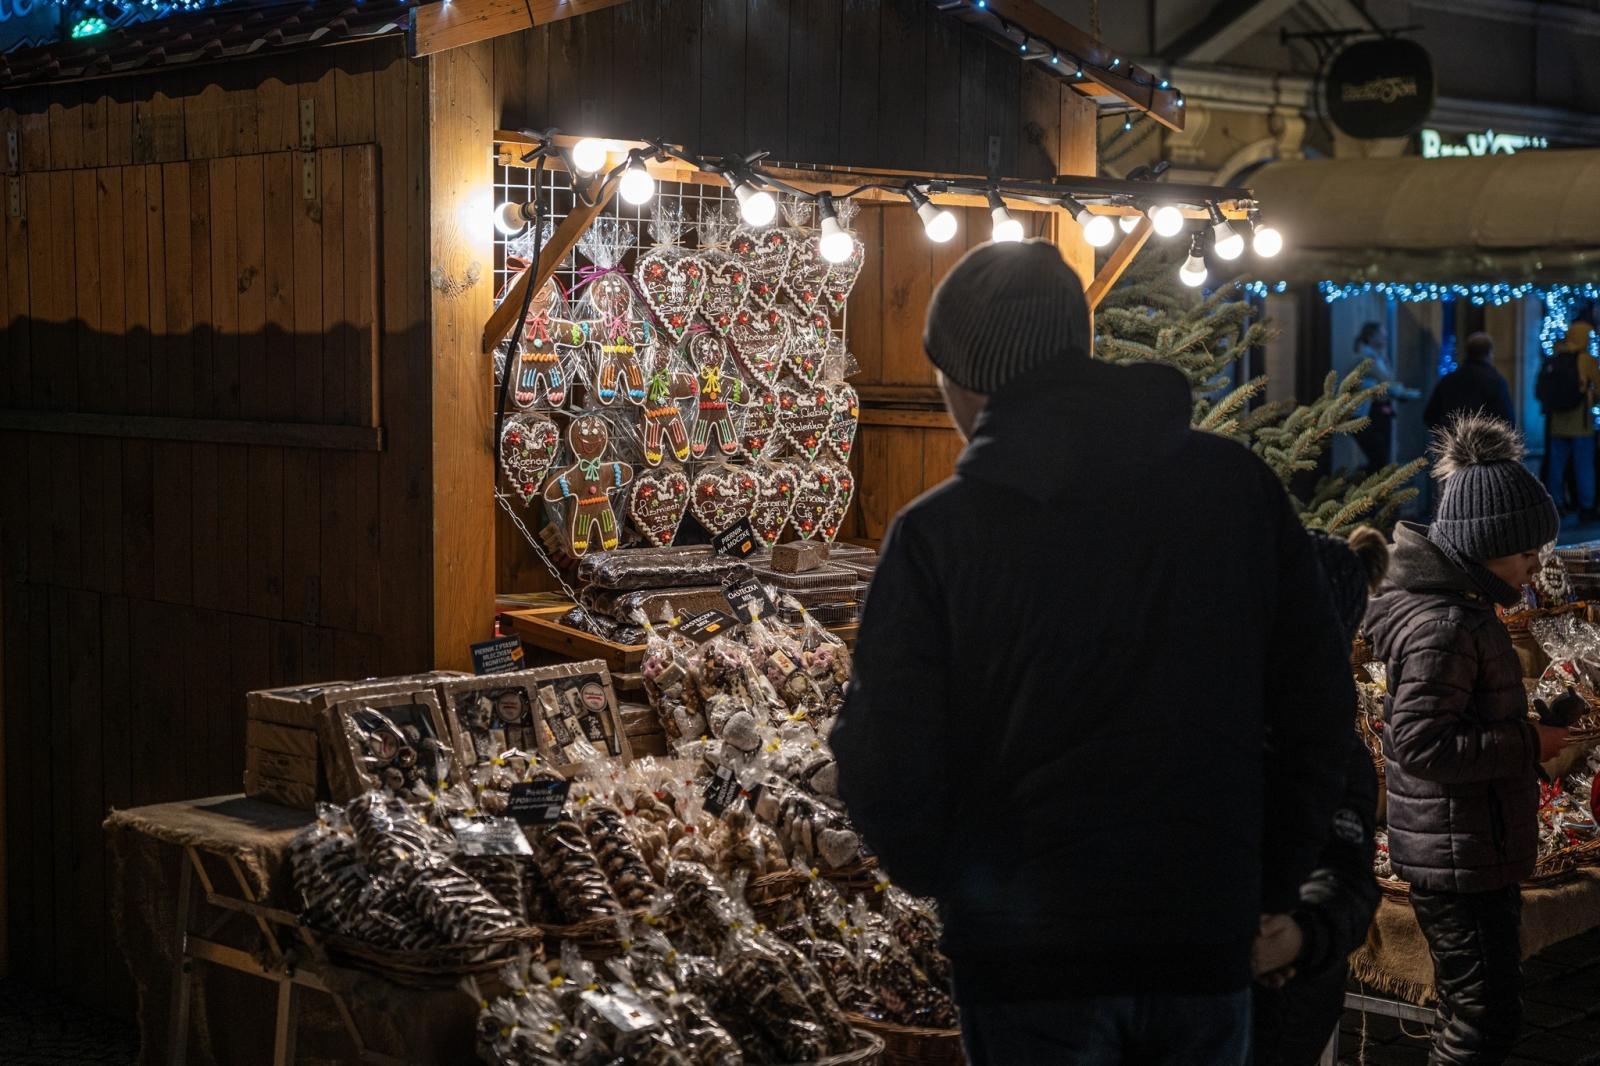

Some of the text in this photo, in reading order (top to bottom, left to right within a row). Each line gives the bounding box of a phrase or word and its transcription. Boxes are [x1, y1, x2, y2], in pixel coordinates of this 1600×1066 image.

[718, 529, 751, 555] NA MOCZKĘ
[721, 526, 743, 544] PIERNIK
[727, 584, 758, 600] CIASTECZKA
[741, 593, 753, 602] MIX
[680, 612, 717, 631] CIASTECZKA
[697, 620, 710, 628] MIX
